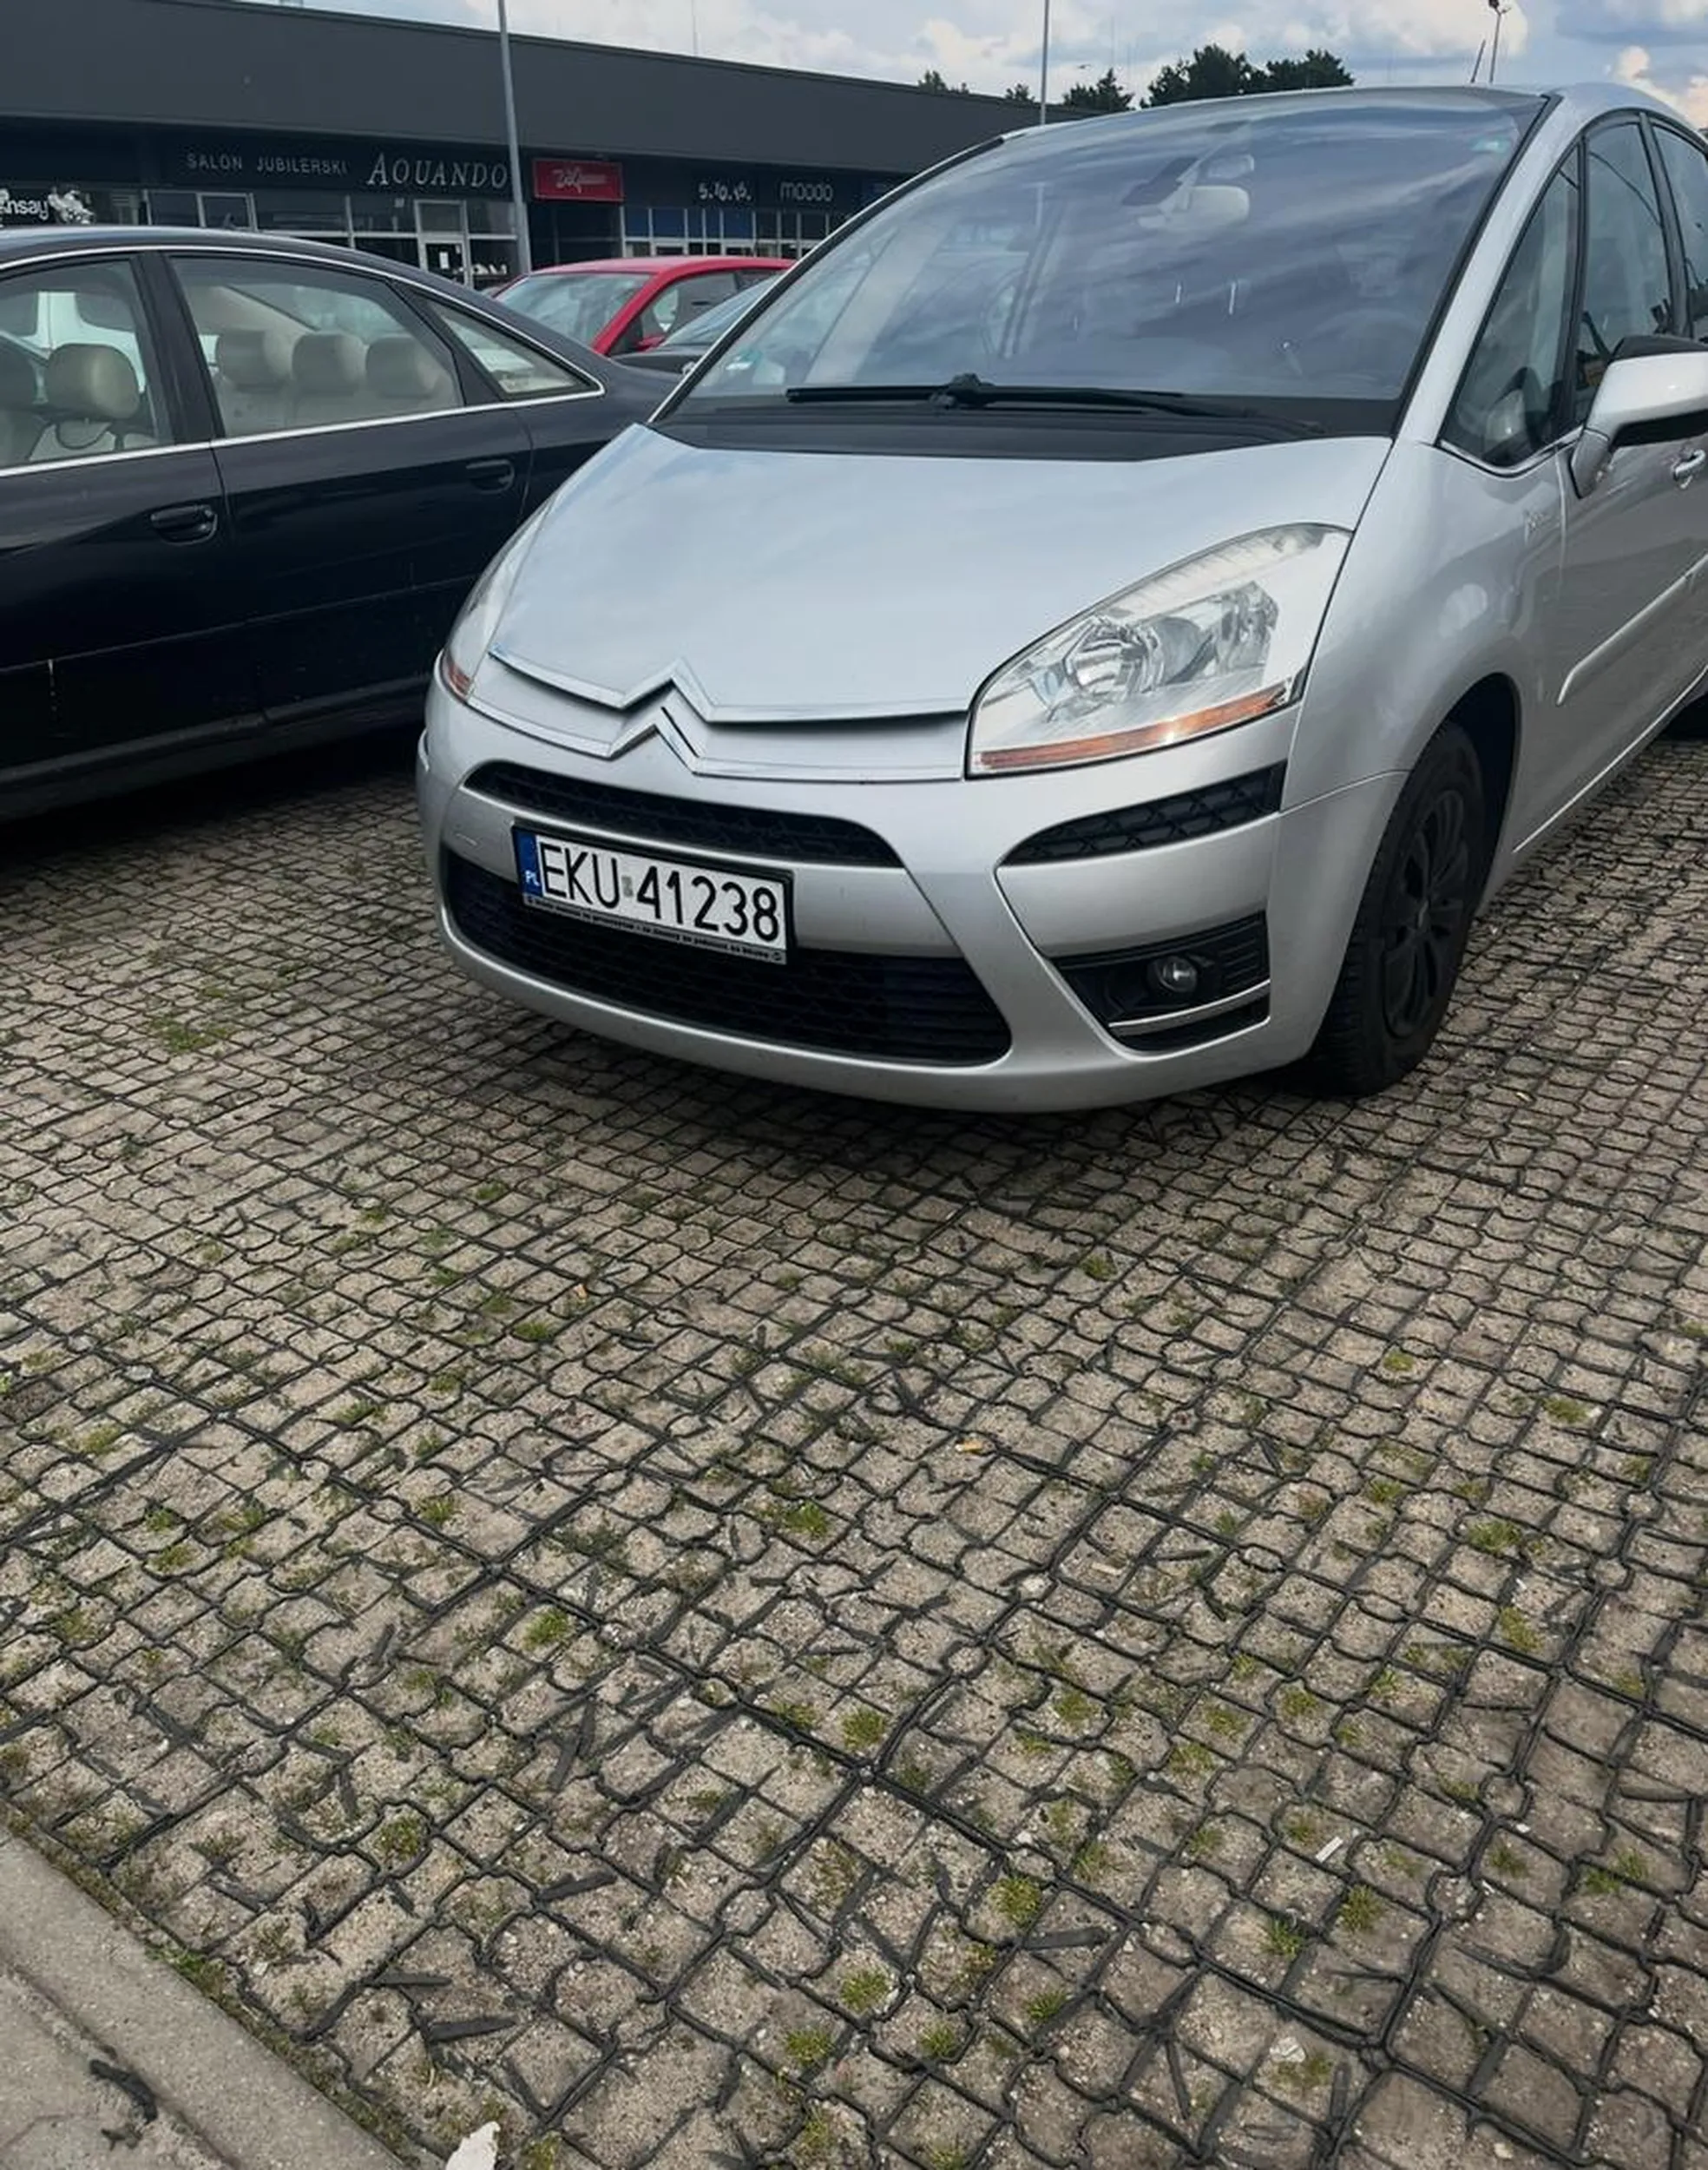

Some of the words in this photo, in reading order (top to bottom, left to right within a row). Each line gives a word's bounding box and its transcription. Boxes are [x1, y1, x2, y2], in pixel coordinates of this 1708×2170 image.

[187, 153, 242, 170] SALON
[257, 156, 348, 174] JUBILERSKI
[525, 871, 540, 886] PL
[540, 842, 620, 910] EKU
[636, 865, 778, 943] 41238
